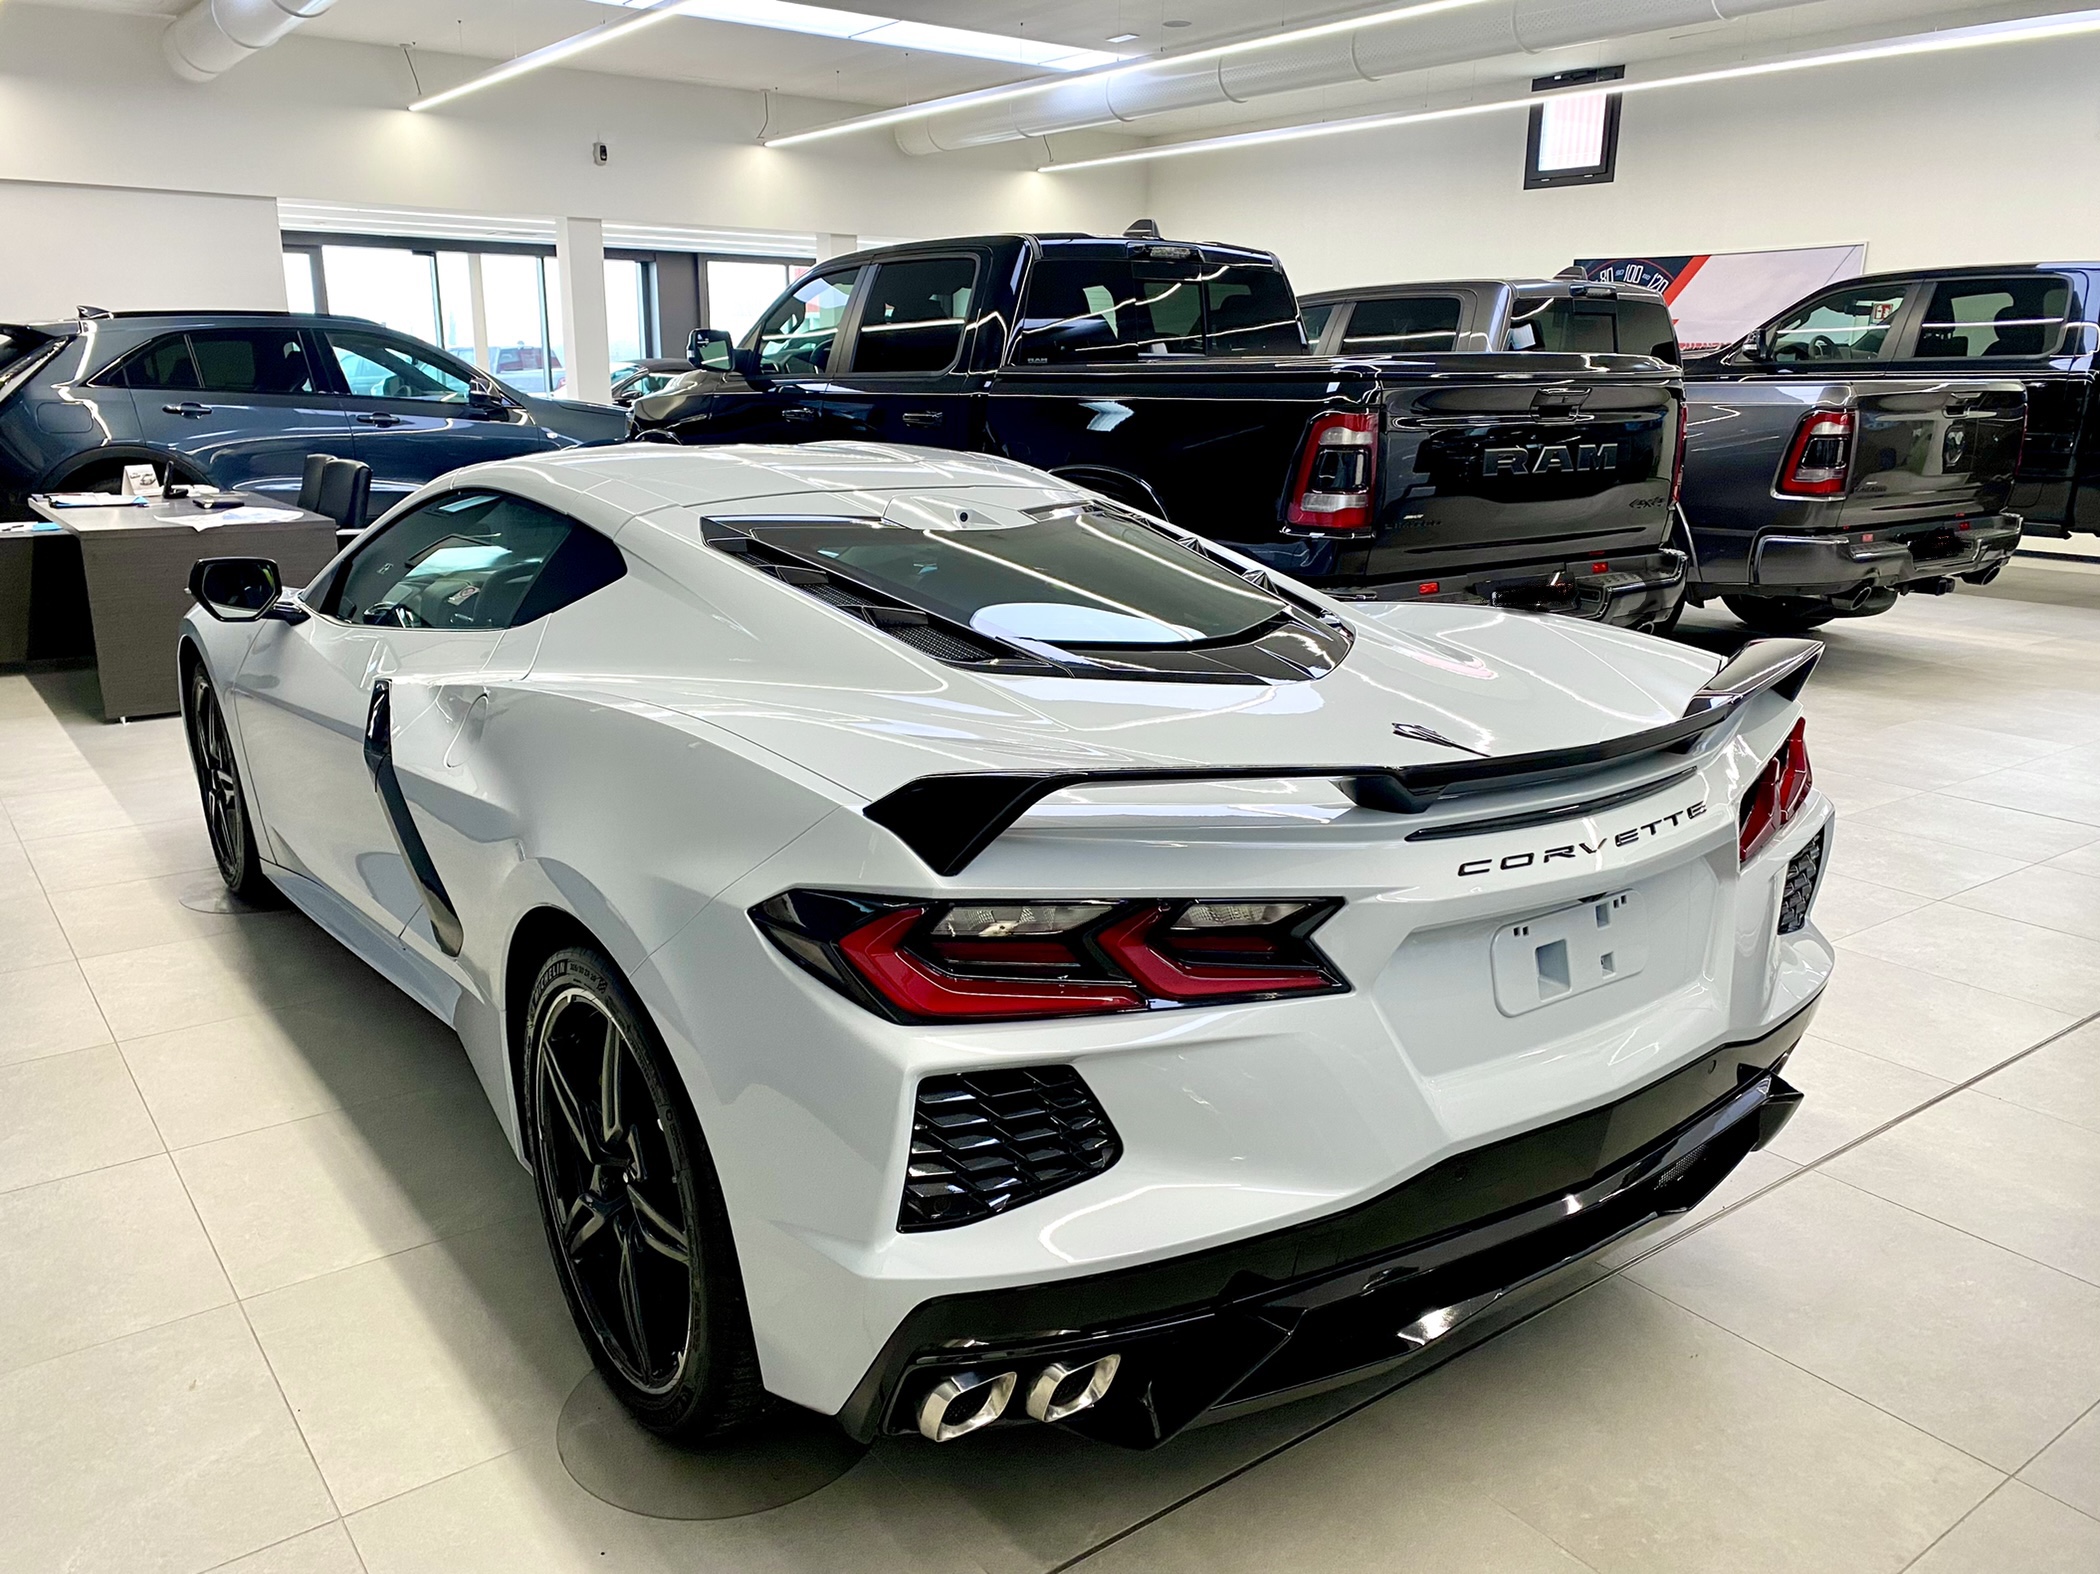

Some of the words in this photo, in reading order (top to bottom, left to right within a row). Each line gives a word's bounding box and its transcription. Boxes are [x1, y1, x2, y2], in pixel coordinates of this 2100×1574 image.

[1599, 267, 1614, 282] 80
[1623, 264, 1644, 283] 100
[1647, 273, 1669, 294] 120
[1483, 443, 1617, 477] RAM
[1458, 801, 1708, 877] CORVETTE
[534, 959, 567, 1006] MICHELIN
